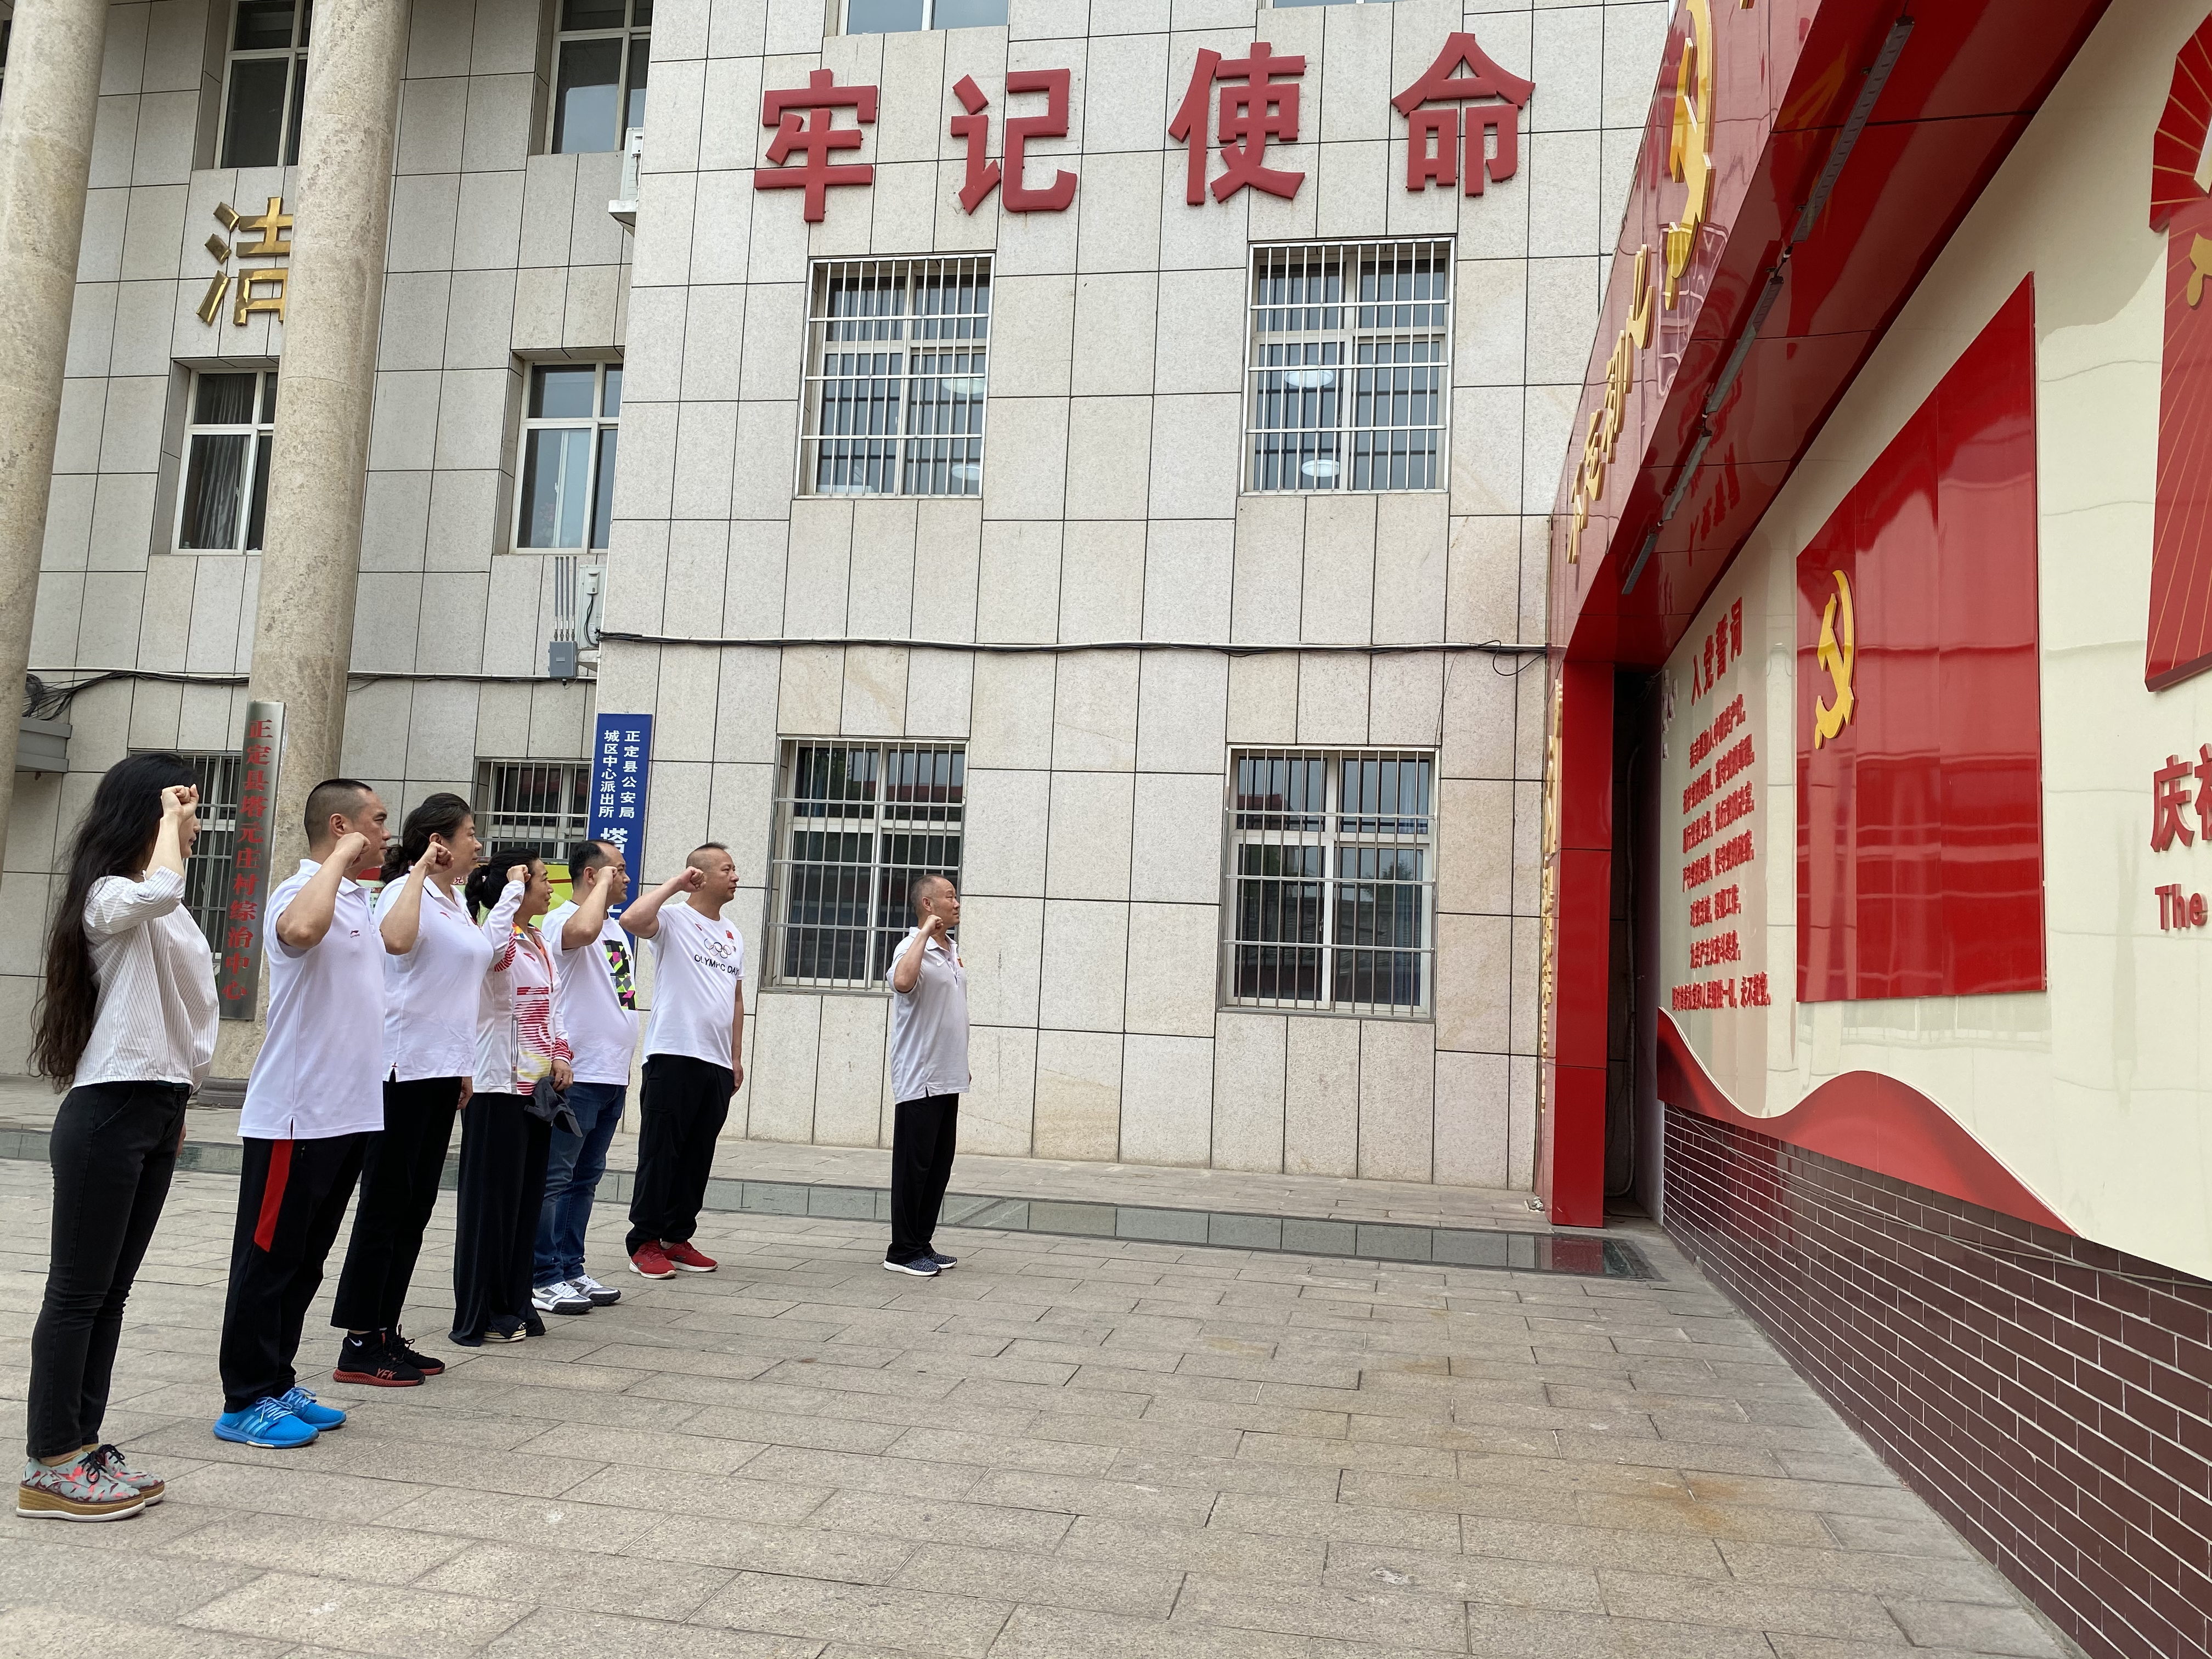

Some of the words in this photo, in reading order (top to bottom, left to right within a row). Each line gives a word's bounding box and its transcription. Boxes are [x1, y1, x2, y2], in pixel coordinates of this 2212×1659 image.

[754, 32, 1535, 222] 牢记使命
[1691, 597, 1743, 706] 入党誓词
[599, 730, 620, 819] 城区中心派出所
[618, 730, 641, 819] 正定县公安局
[222, 720, 273, 1001] 正定县塔元庄村综治中心
[2155, 883, 2208, 930] The
[727, 966, 739, 975] DAY
[376, 1368, 397, 1380] YFK
